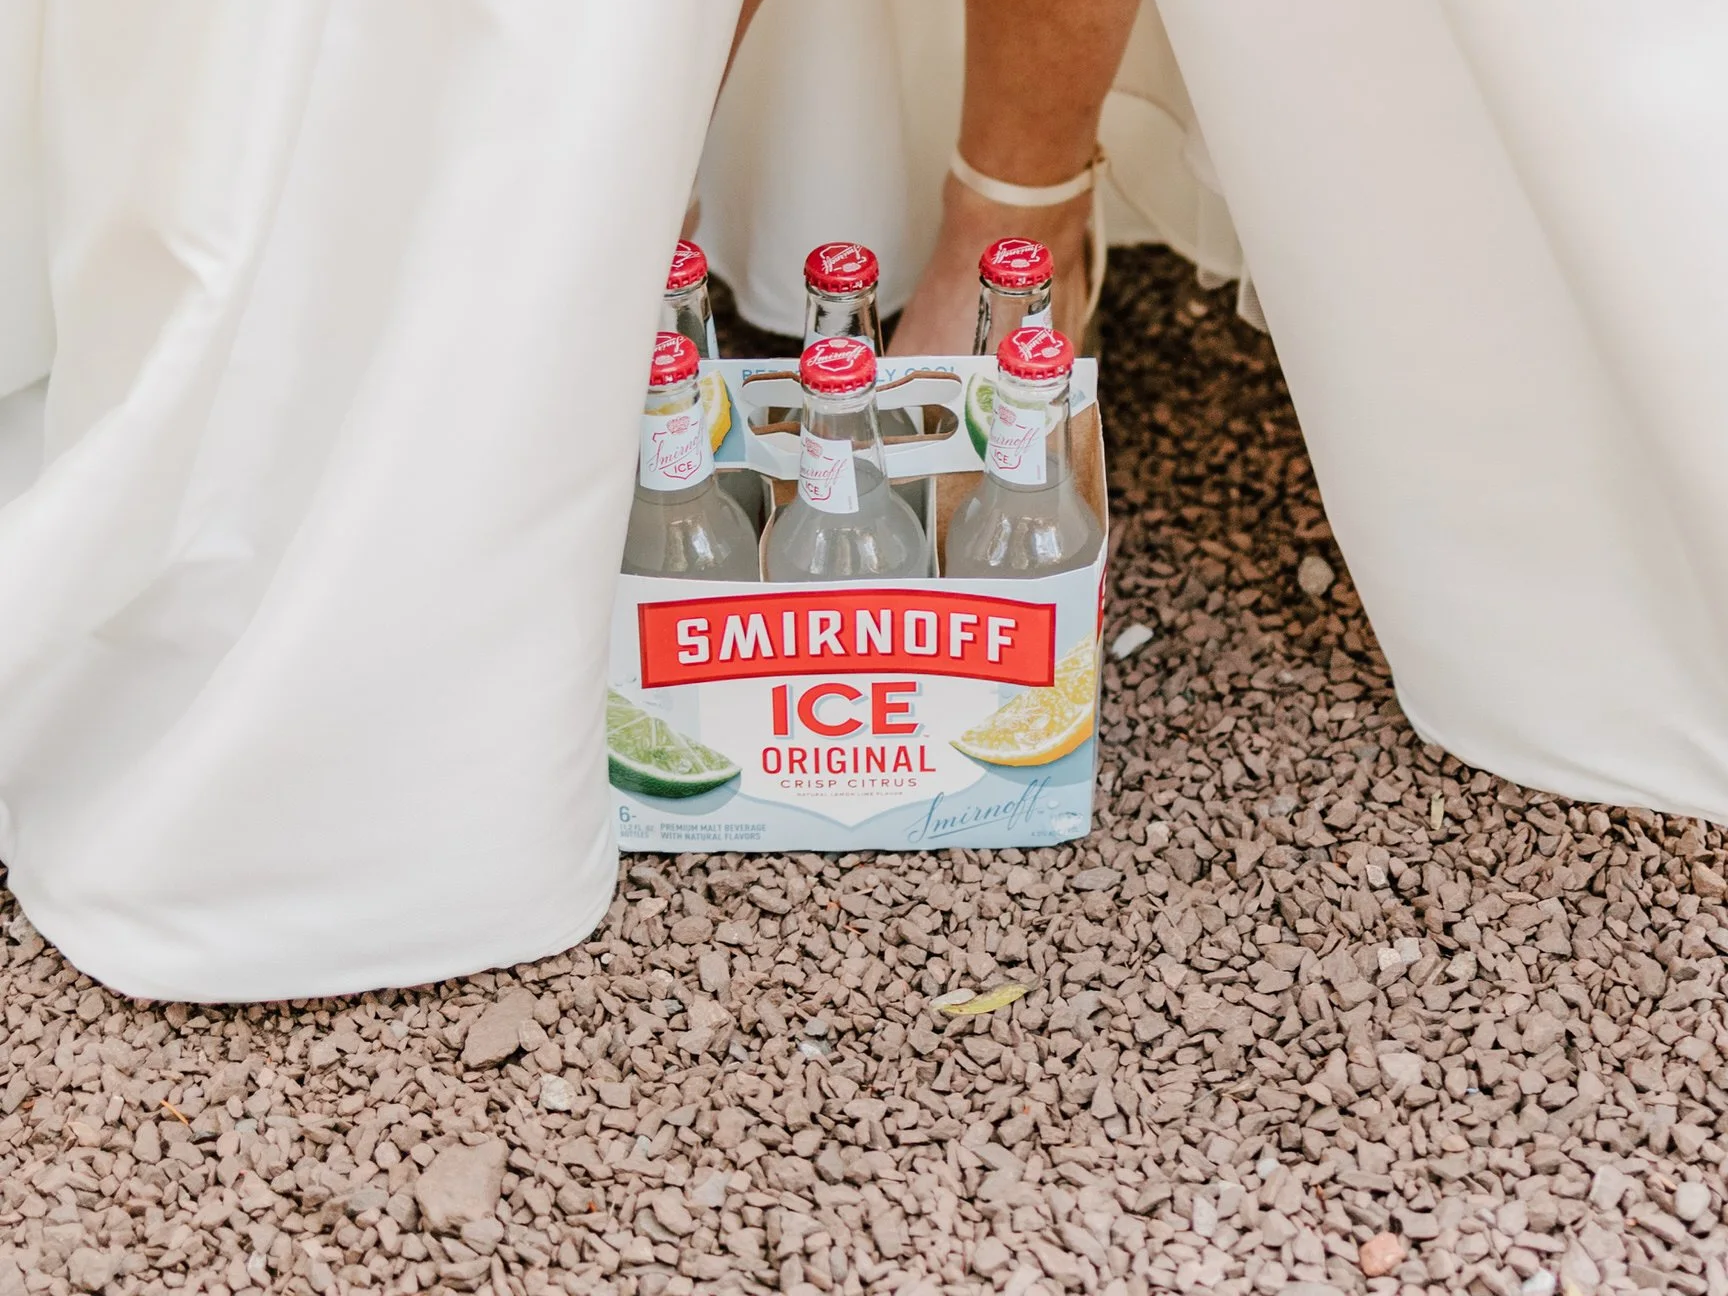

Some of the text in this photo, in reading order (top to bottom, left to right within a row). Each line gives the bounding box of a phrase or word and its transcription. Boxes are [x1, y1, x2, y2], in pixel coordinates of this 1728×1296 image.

[806, 345, 867, 366] Smirnoff
[674, 460, 693, 473] ICE
[675, 608, 1018, 666] SMIRNOFF
[771, 681, 922, 739] ICE
[762, 745, 937, 775] ORIGINAL
[780, 777, 919, 789] CRISP CITRUS
[907, 776, 1051, 843] Smirnoff
[660, 823, 767, 832] PREMIUM MALT BEVERAGE
[660, 832, 761, 841] WITH NATURAL FLAVORS
